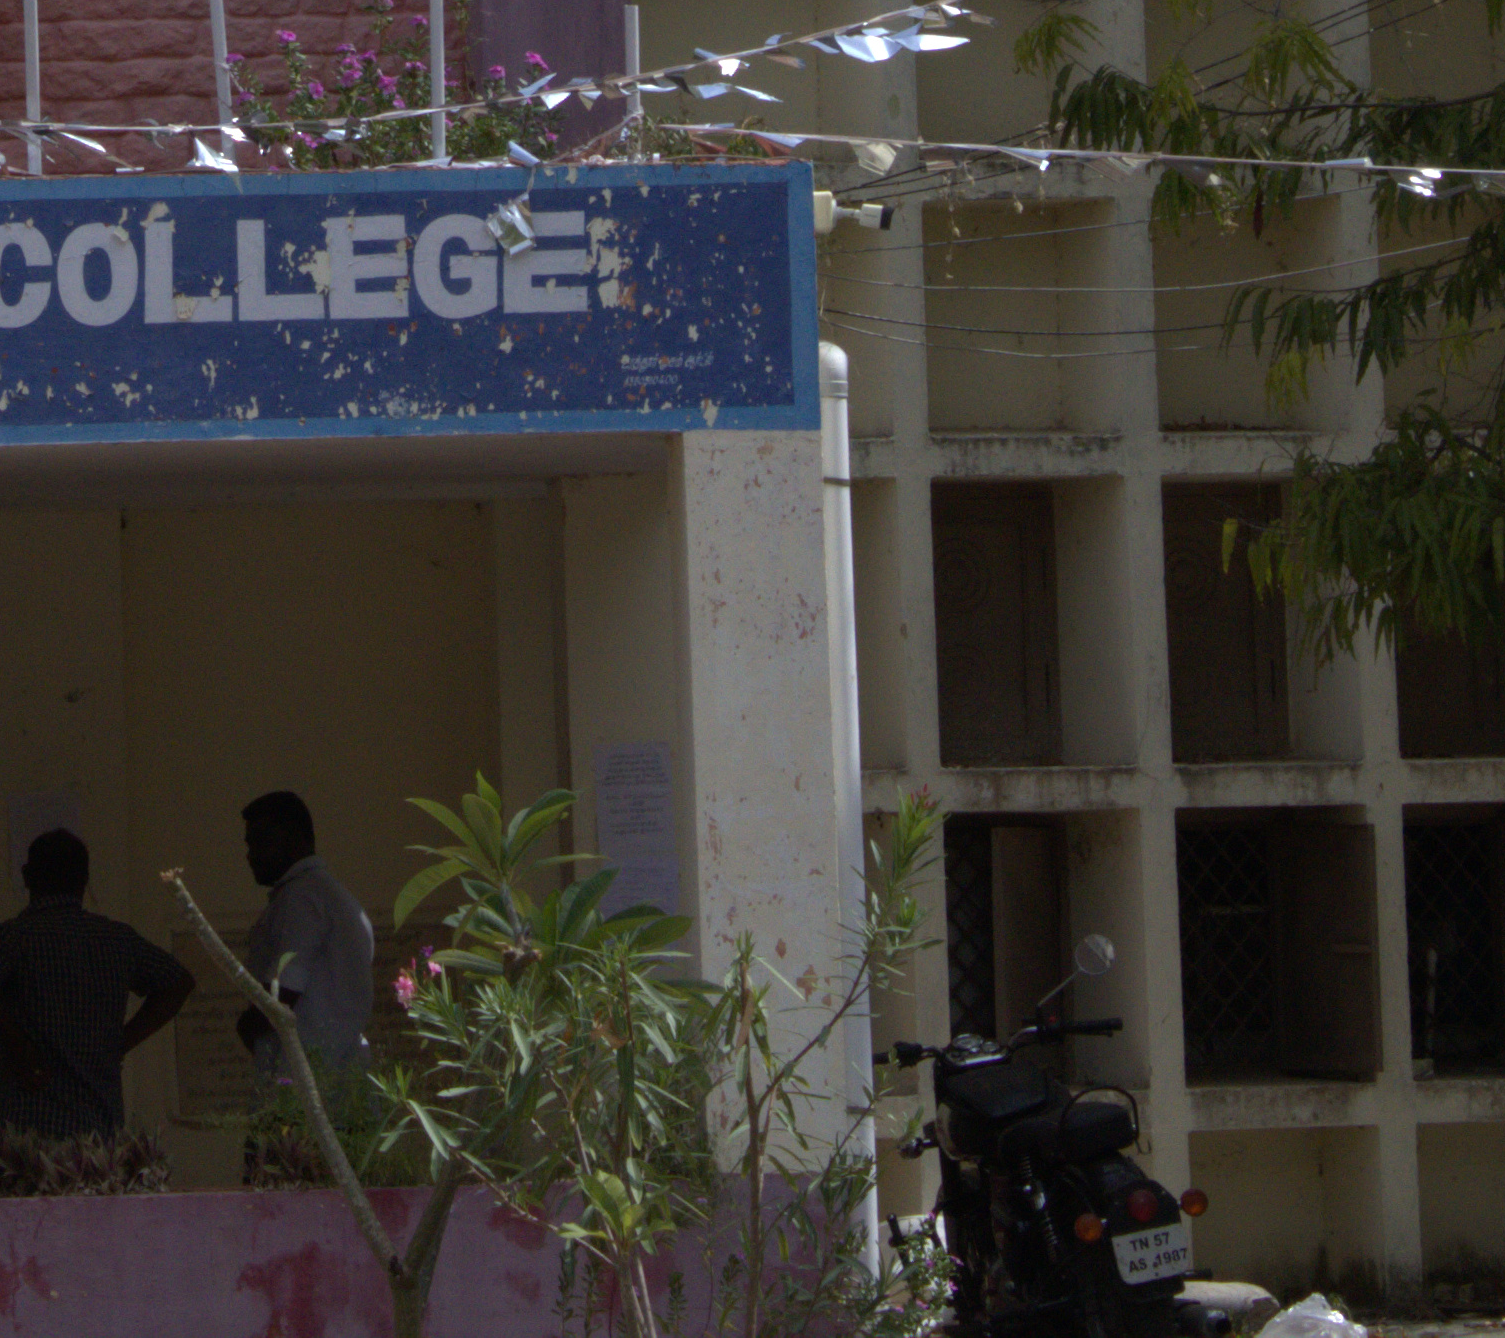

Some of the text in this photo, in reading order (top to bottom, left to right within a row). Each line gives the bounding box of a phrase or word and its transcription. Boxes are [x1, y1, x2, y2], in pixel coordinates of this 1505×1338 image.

[1129, 1231, 1170, 1252] TN 57
[1128, 1257, 1148, 1273] AS
